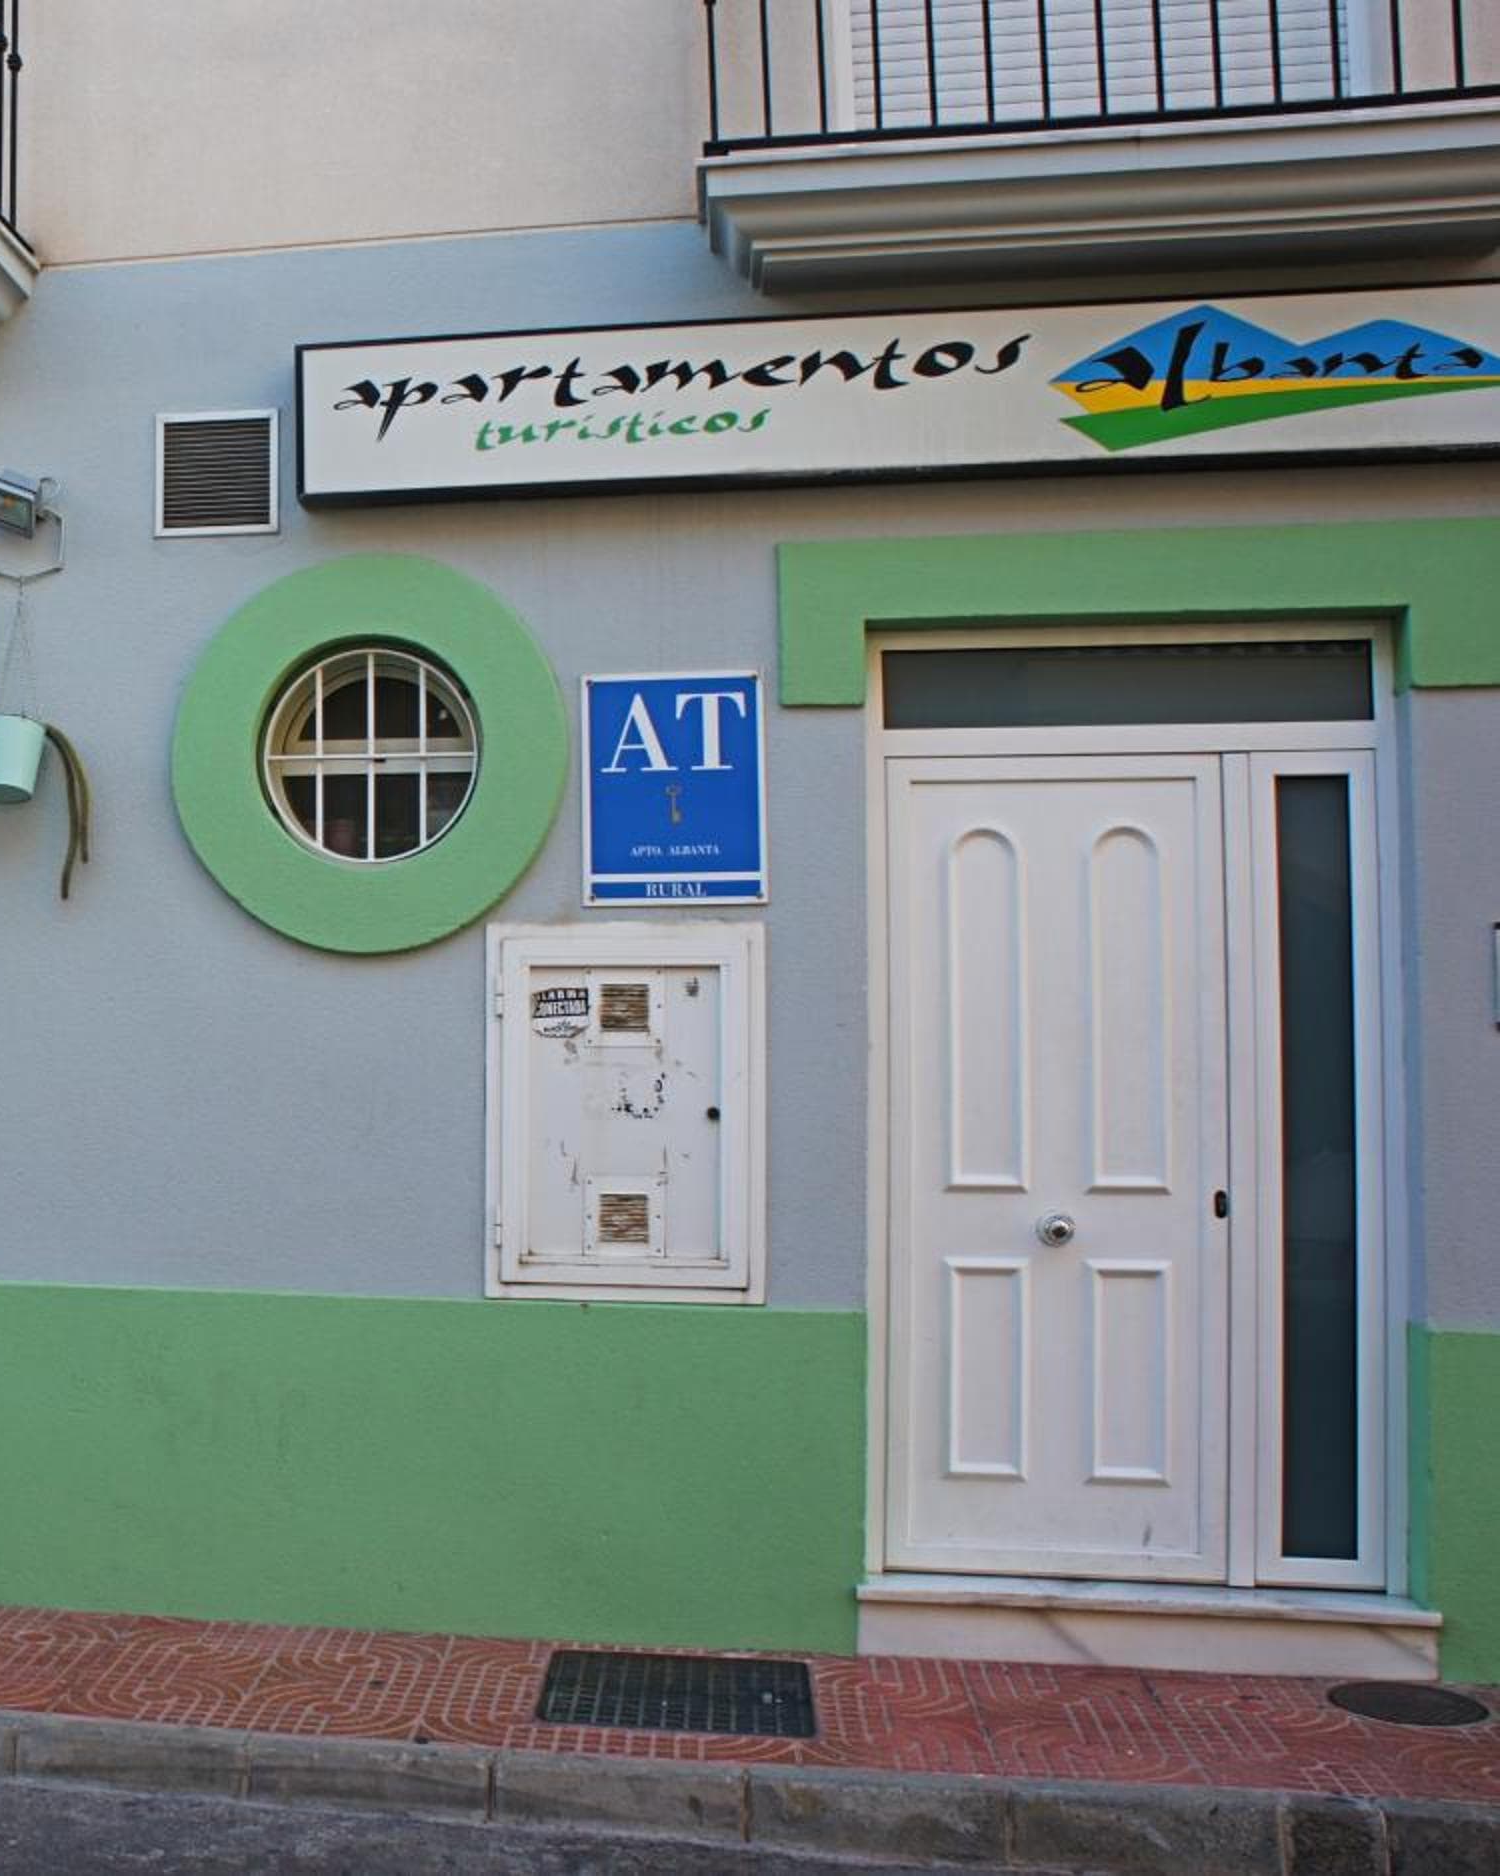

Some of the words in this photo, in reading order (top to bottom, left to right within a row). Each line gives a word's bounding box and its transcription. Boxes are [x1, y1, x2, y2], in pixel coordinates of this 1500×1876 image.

[332, 333, 1033, 443] apartamentos
[1075, 319, 1485, 412] albanta
[601, 692, 747, 773] AT
[645, 883, 707, 897] RURAL
[668, 844, 720, 856] ALBANTA
